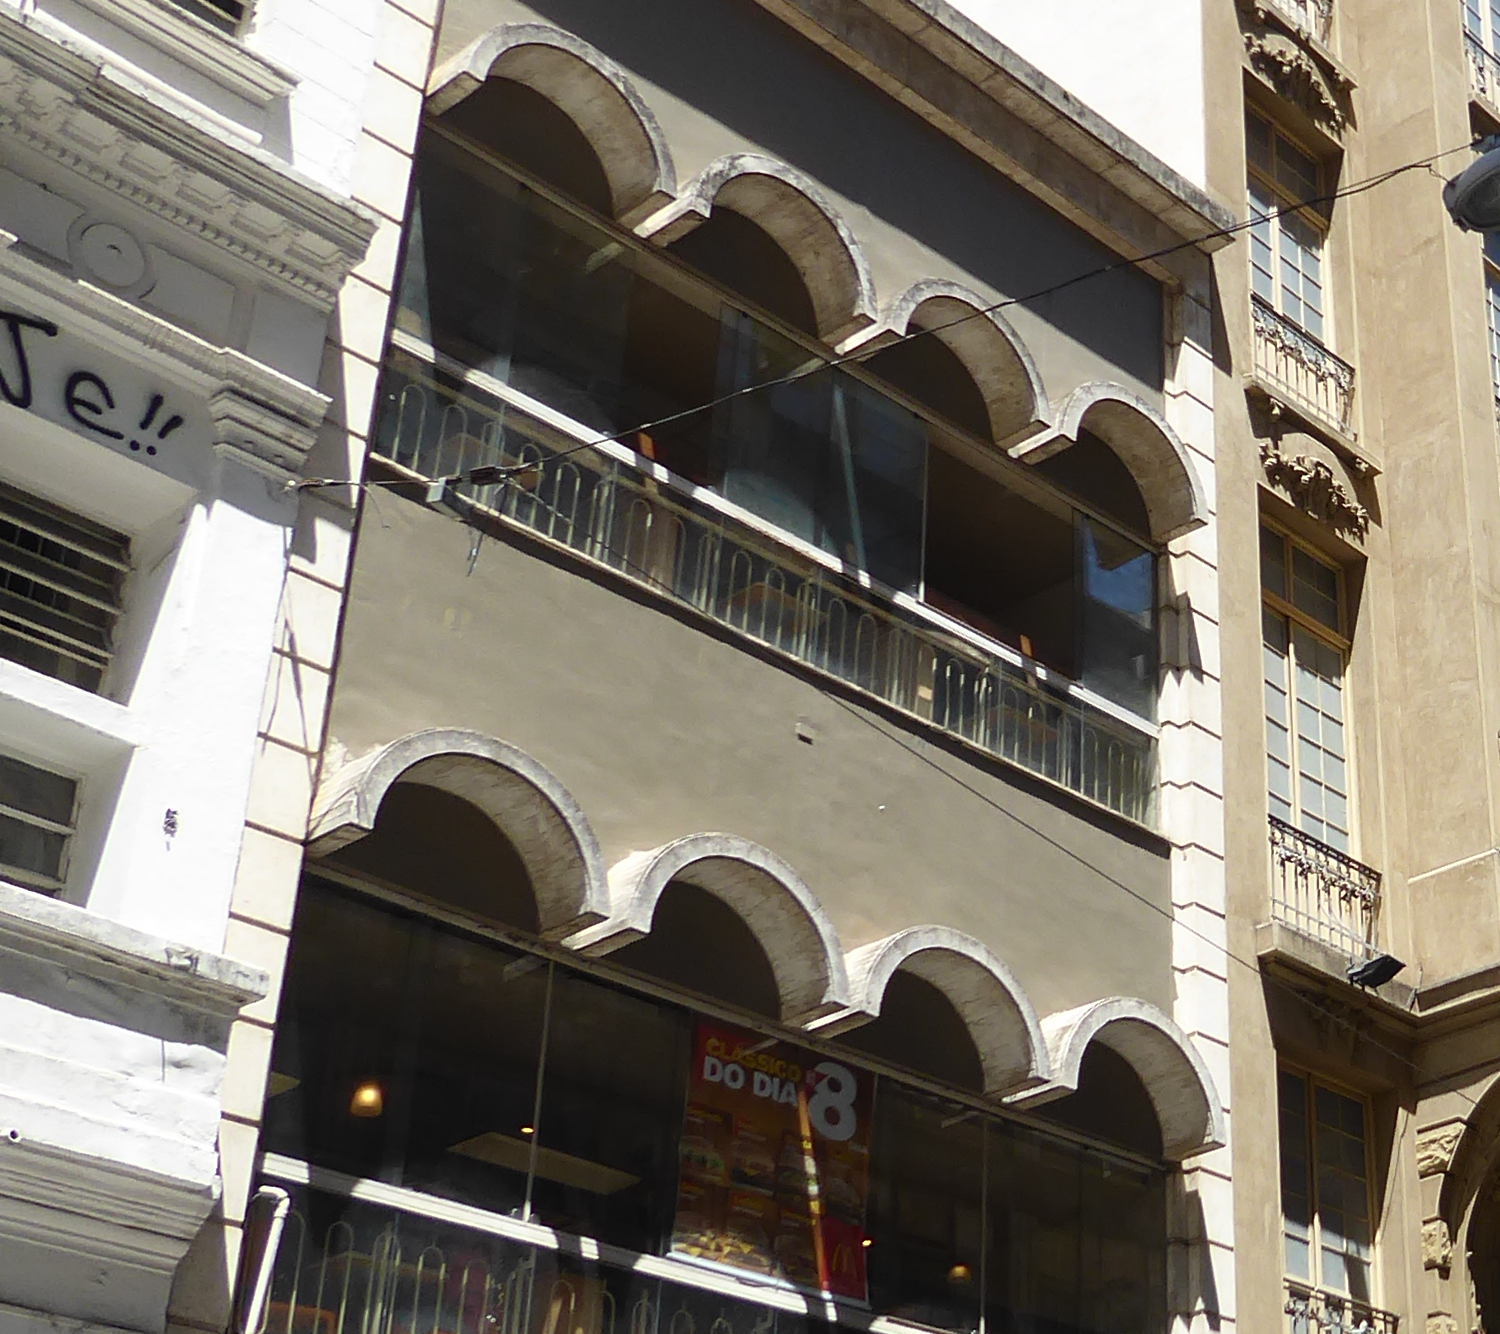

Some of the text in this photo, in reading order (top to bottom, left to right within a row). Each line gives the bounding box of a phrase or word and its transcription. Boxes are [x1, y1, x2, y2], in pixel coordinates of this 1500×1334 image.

[703, 1055, 746, 1089] DO
[752, 1071, 799, 1107] DIA
[808, 1062, 858, 1141] 8
